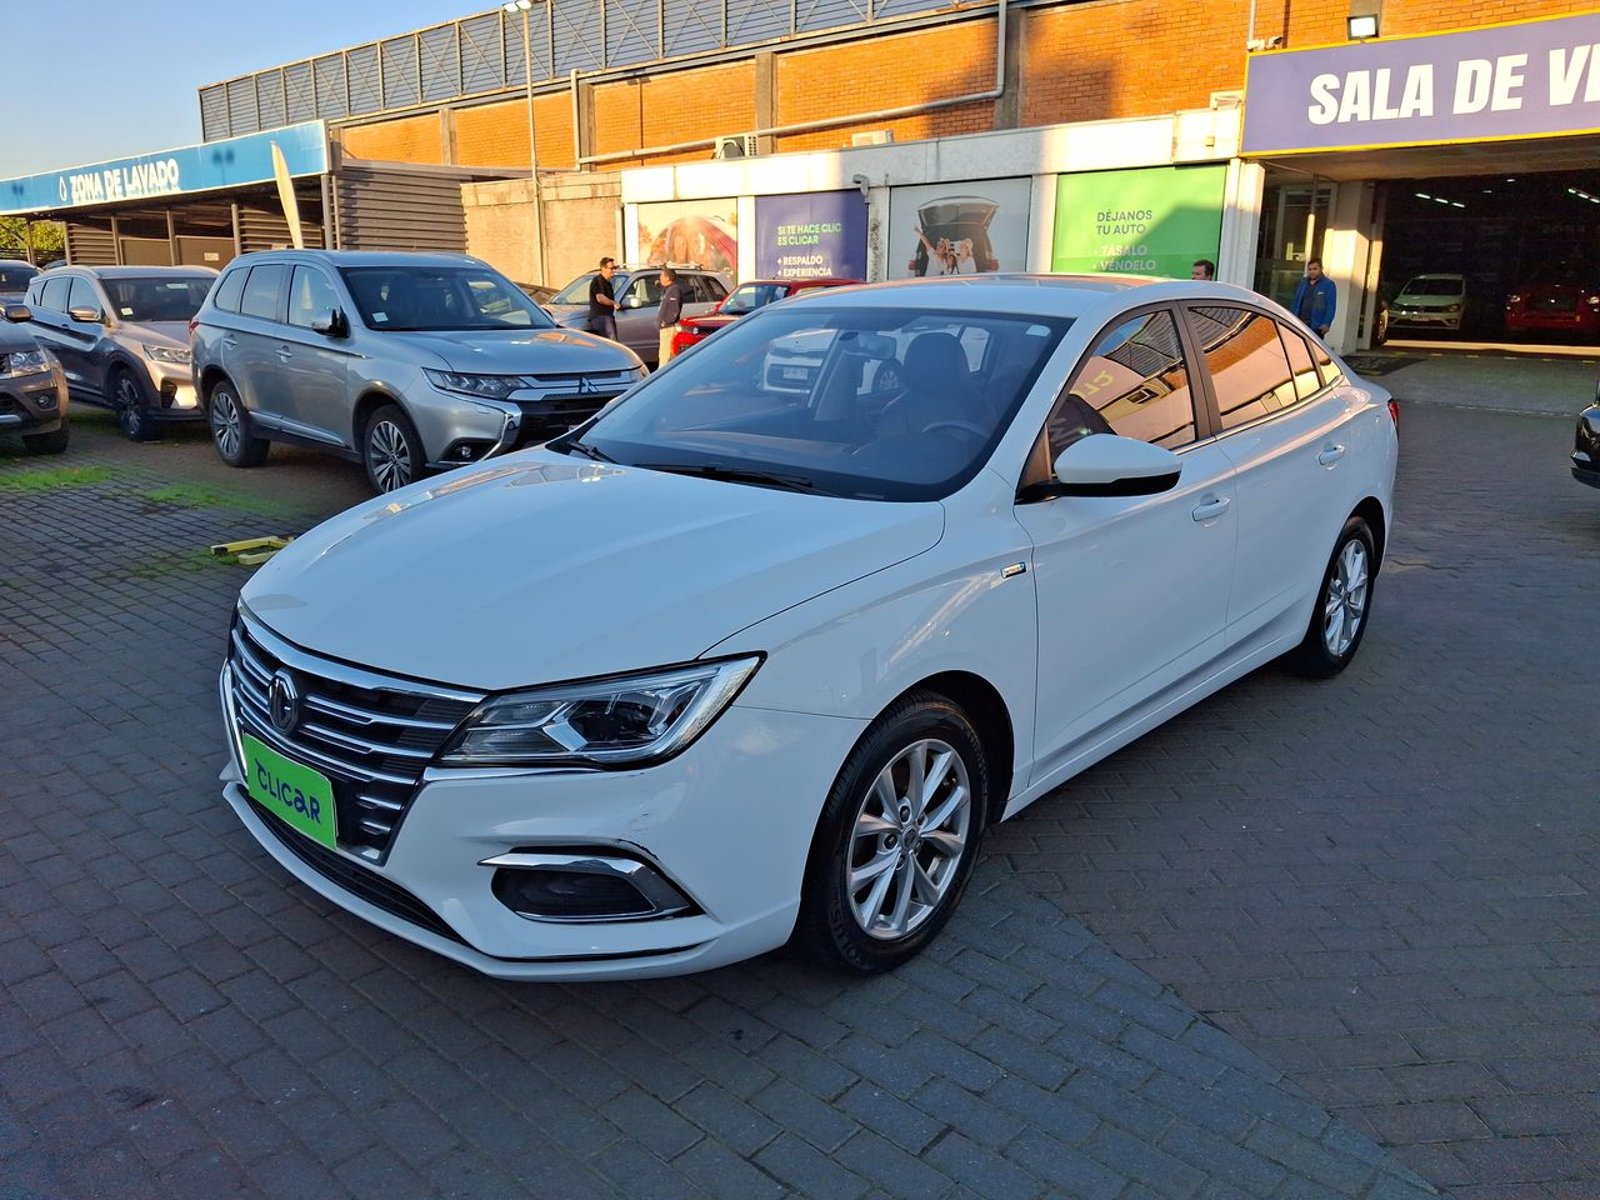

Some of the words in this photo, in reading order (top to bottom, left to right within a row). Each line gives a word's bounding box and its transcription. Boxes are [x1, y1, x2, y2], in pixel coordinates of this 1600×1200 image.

[1308, 64, 1434, 125] SALA
[1453, 53, 1529, 115] DE
[69, 172, 104, 194] ZONA
[104, 168, 122, 192] DE
[123, 158, 179, 190] LAVADO
[1097, 209, 1153, 222] DÉJANOS
[777, 226, 786, 235] SI
[786, 225, 796, 234] TE
[797, 224, 820, 234] HACE
[821, 222, 842, 233] CLIC
[1096, 225, 1111, 235] TU
[1113, 224, 1146, 235] AUTO
[777, 236, 787, 246] ES
[788, 235, 819, 245] CLICAR
[783, 255, 823, 266] RESPALDO
[1100, 258, 1156, 271] VÉNDELO
[783, 267, 832, 277] EXPERIENCIA
